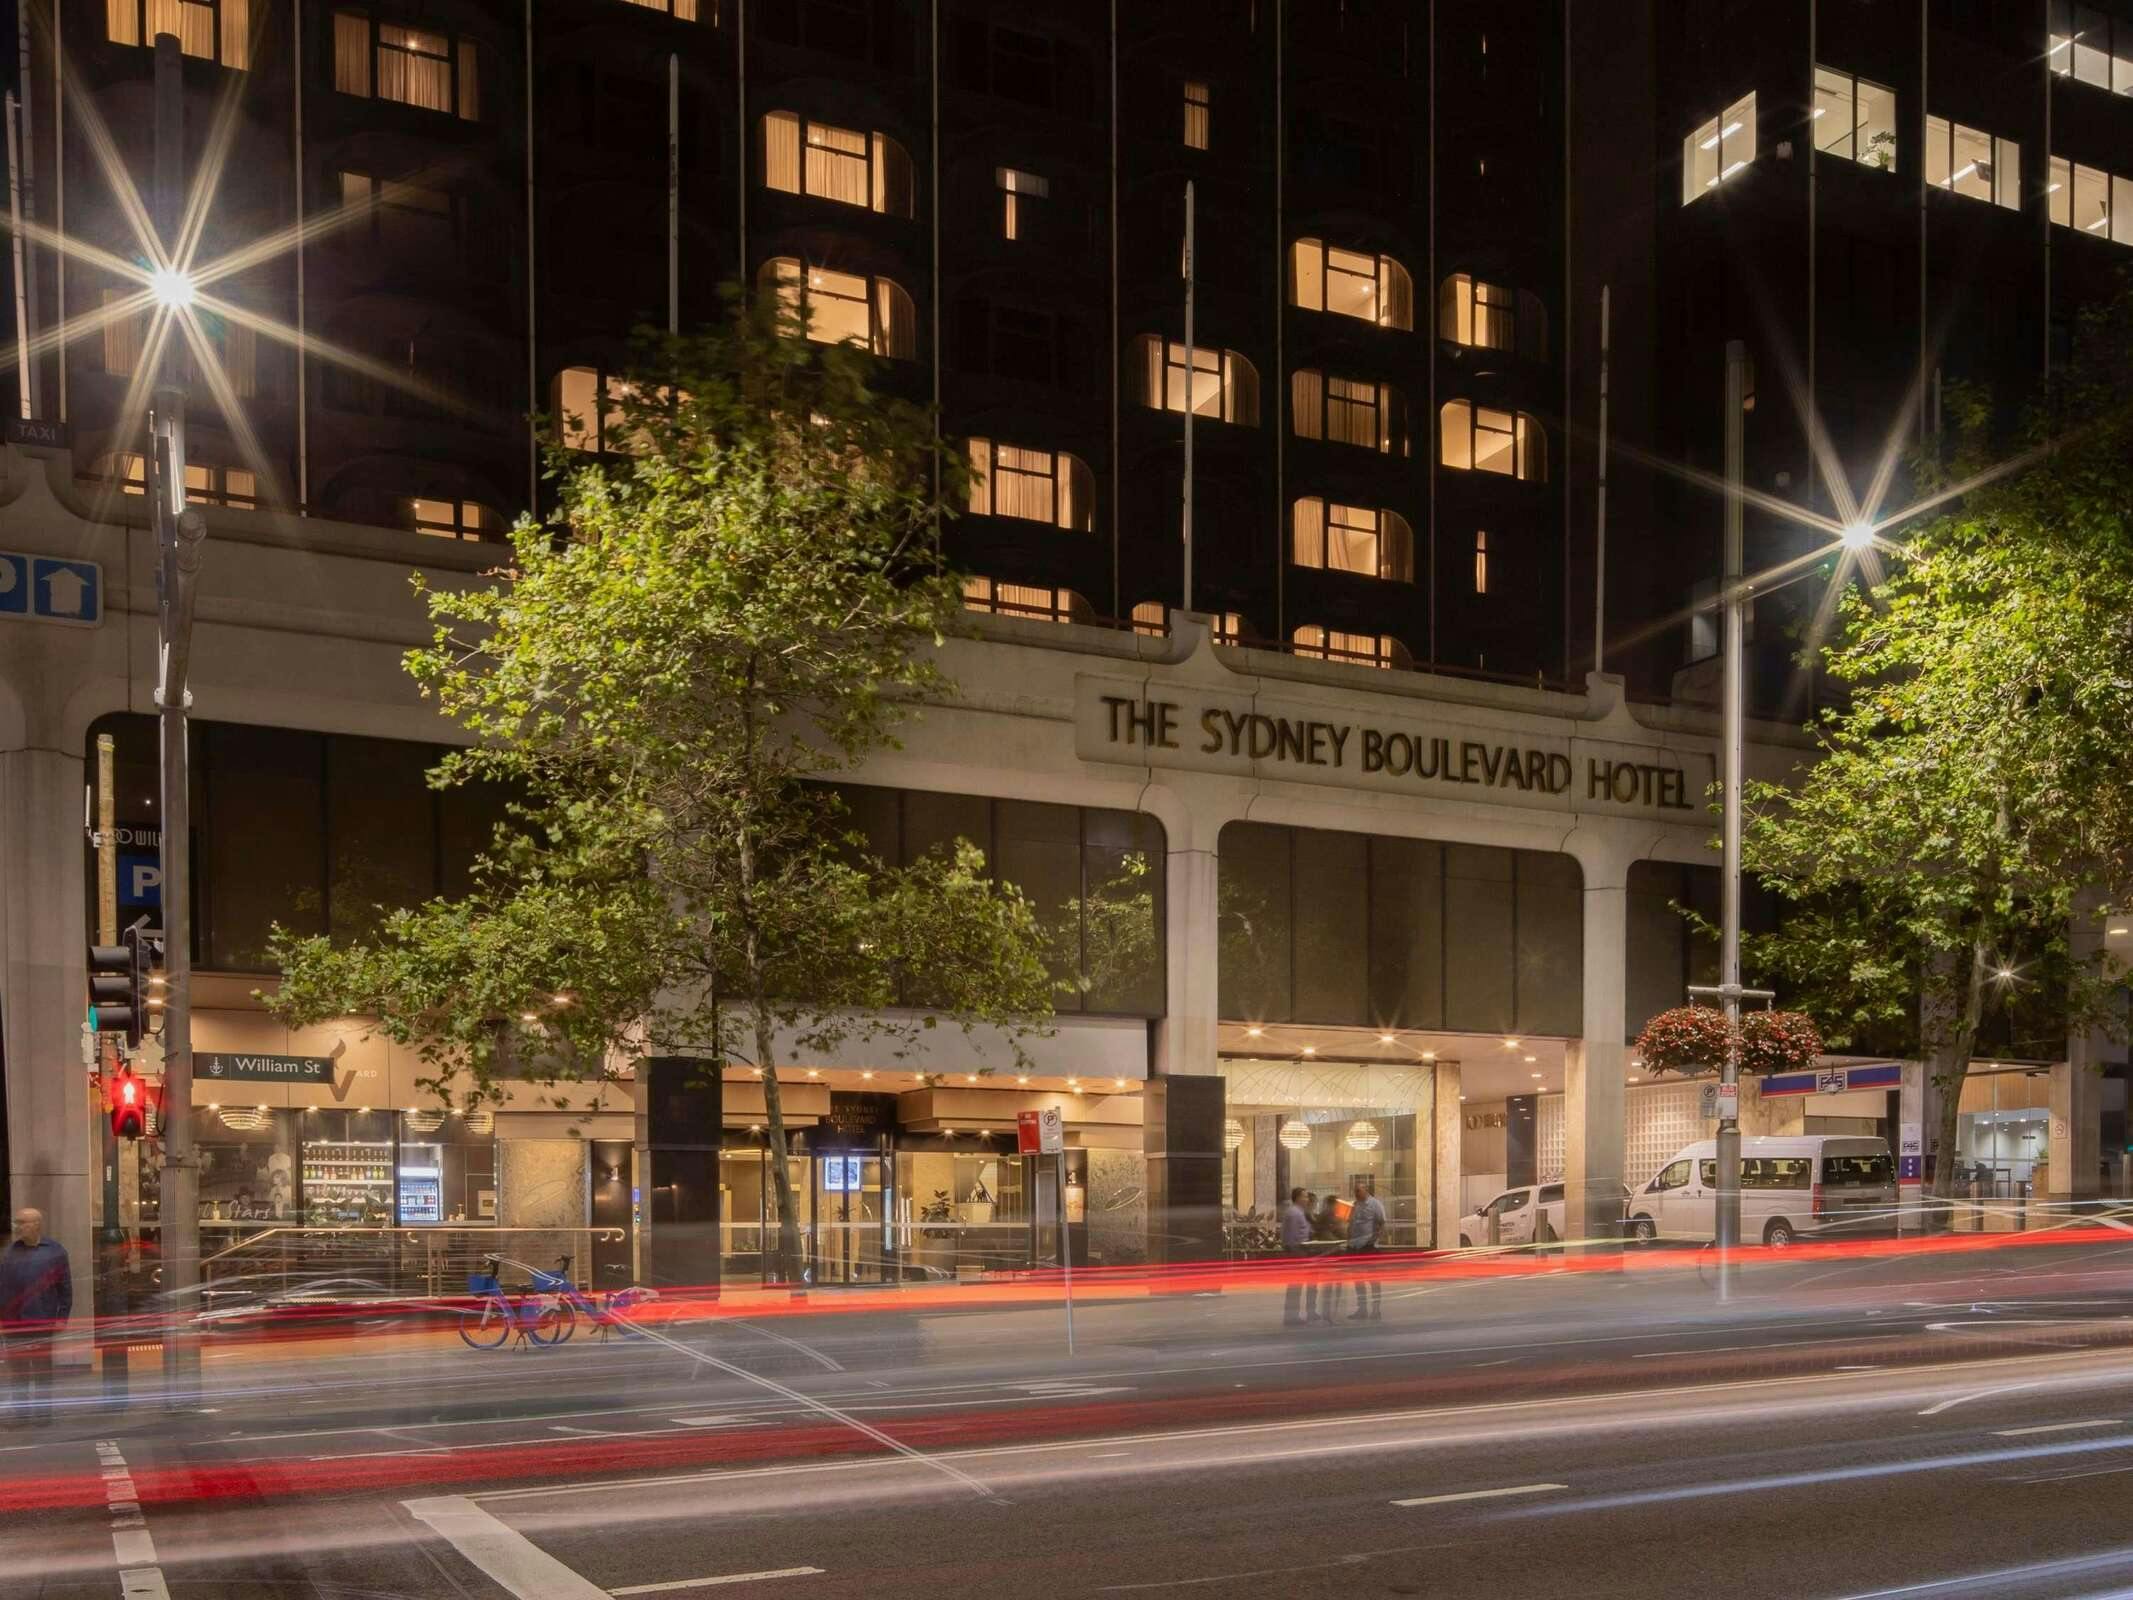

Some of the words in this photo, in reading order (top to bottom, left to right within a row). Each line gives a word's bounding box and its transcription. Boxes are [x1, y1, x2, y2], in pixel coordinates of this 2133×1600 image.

[18, 424, 56, 441] TAXI
[1101, 697, 1180, 749] THE
[1201, 708, 1350, 768] SYDNEY
[1361, 729, 1572, 795] BOULEVARD
[1588, 756, 1693, 811] HOTEL
[133, 865, 162, 897] P
[235, 1057, 298, 1073] William
[304, 1060, 320, 1074] St
[226, 1199, 272, 1219] Stars
